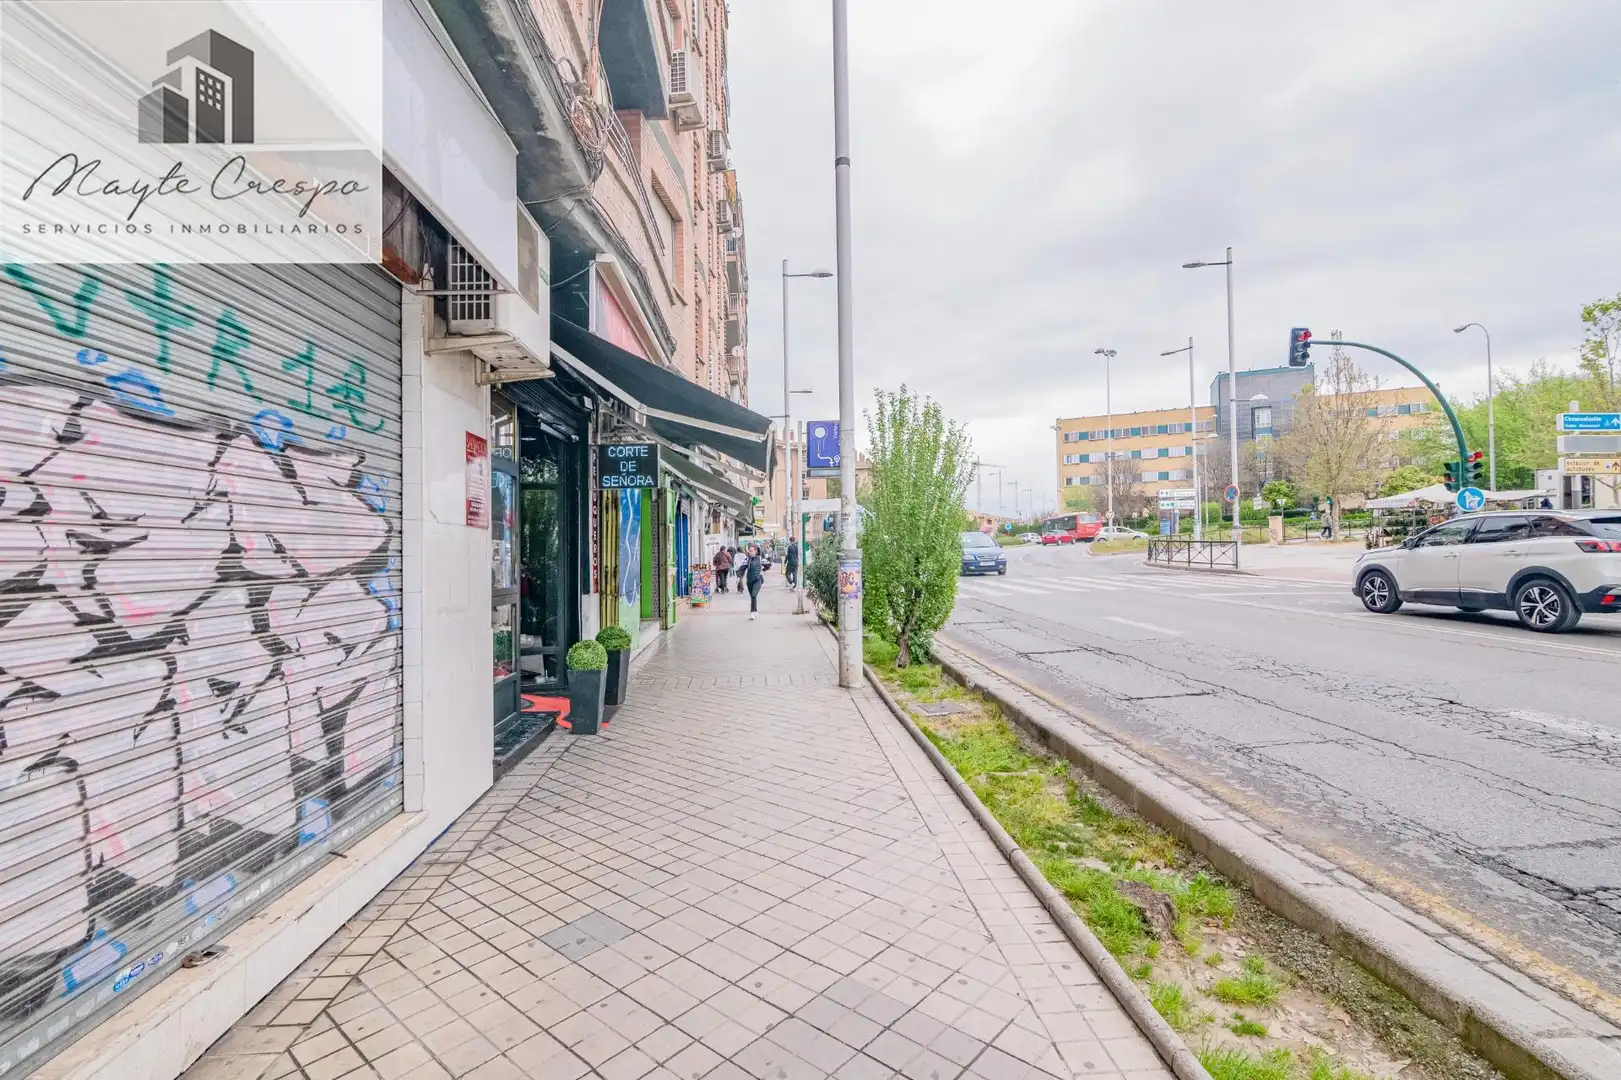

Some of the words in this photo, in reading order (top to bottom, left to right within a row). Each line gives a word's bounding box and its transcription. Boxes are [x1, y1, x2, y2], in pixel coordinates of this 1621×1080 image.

[607, 446, 649, 458] CORTE
[620, 461, 637, 472] DE
[602, 472, 654, 487] SEÑORA
